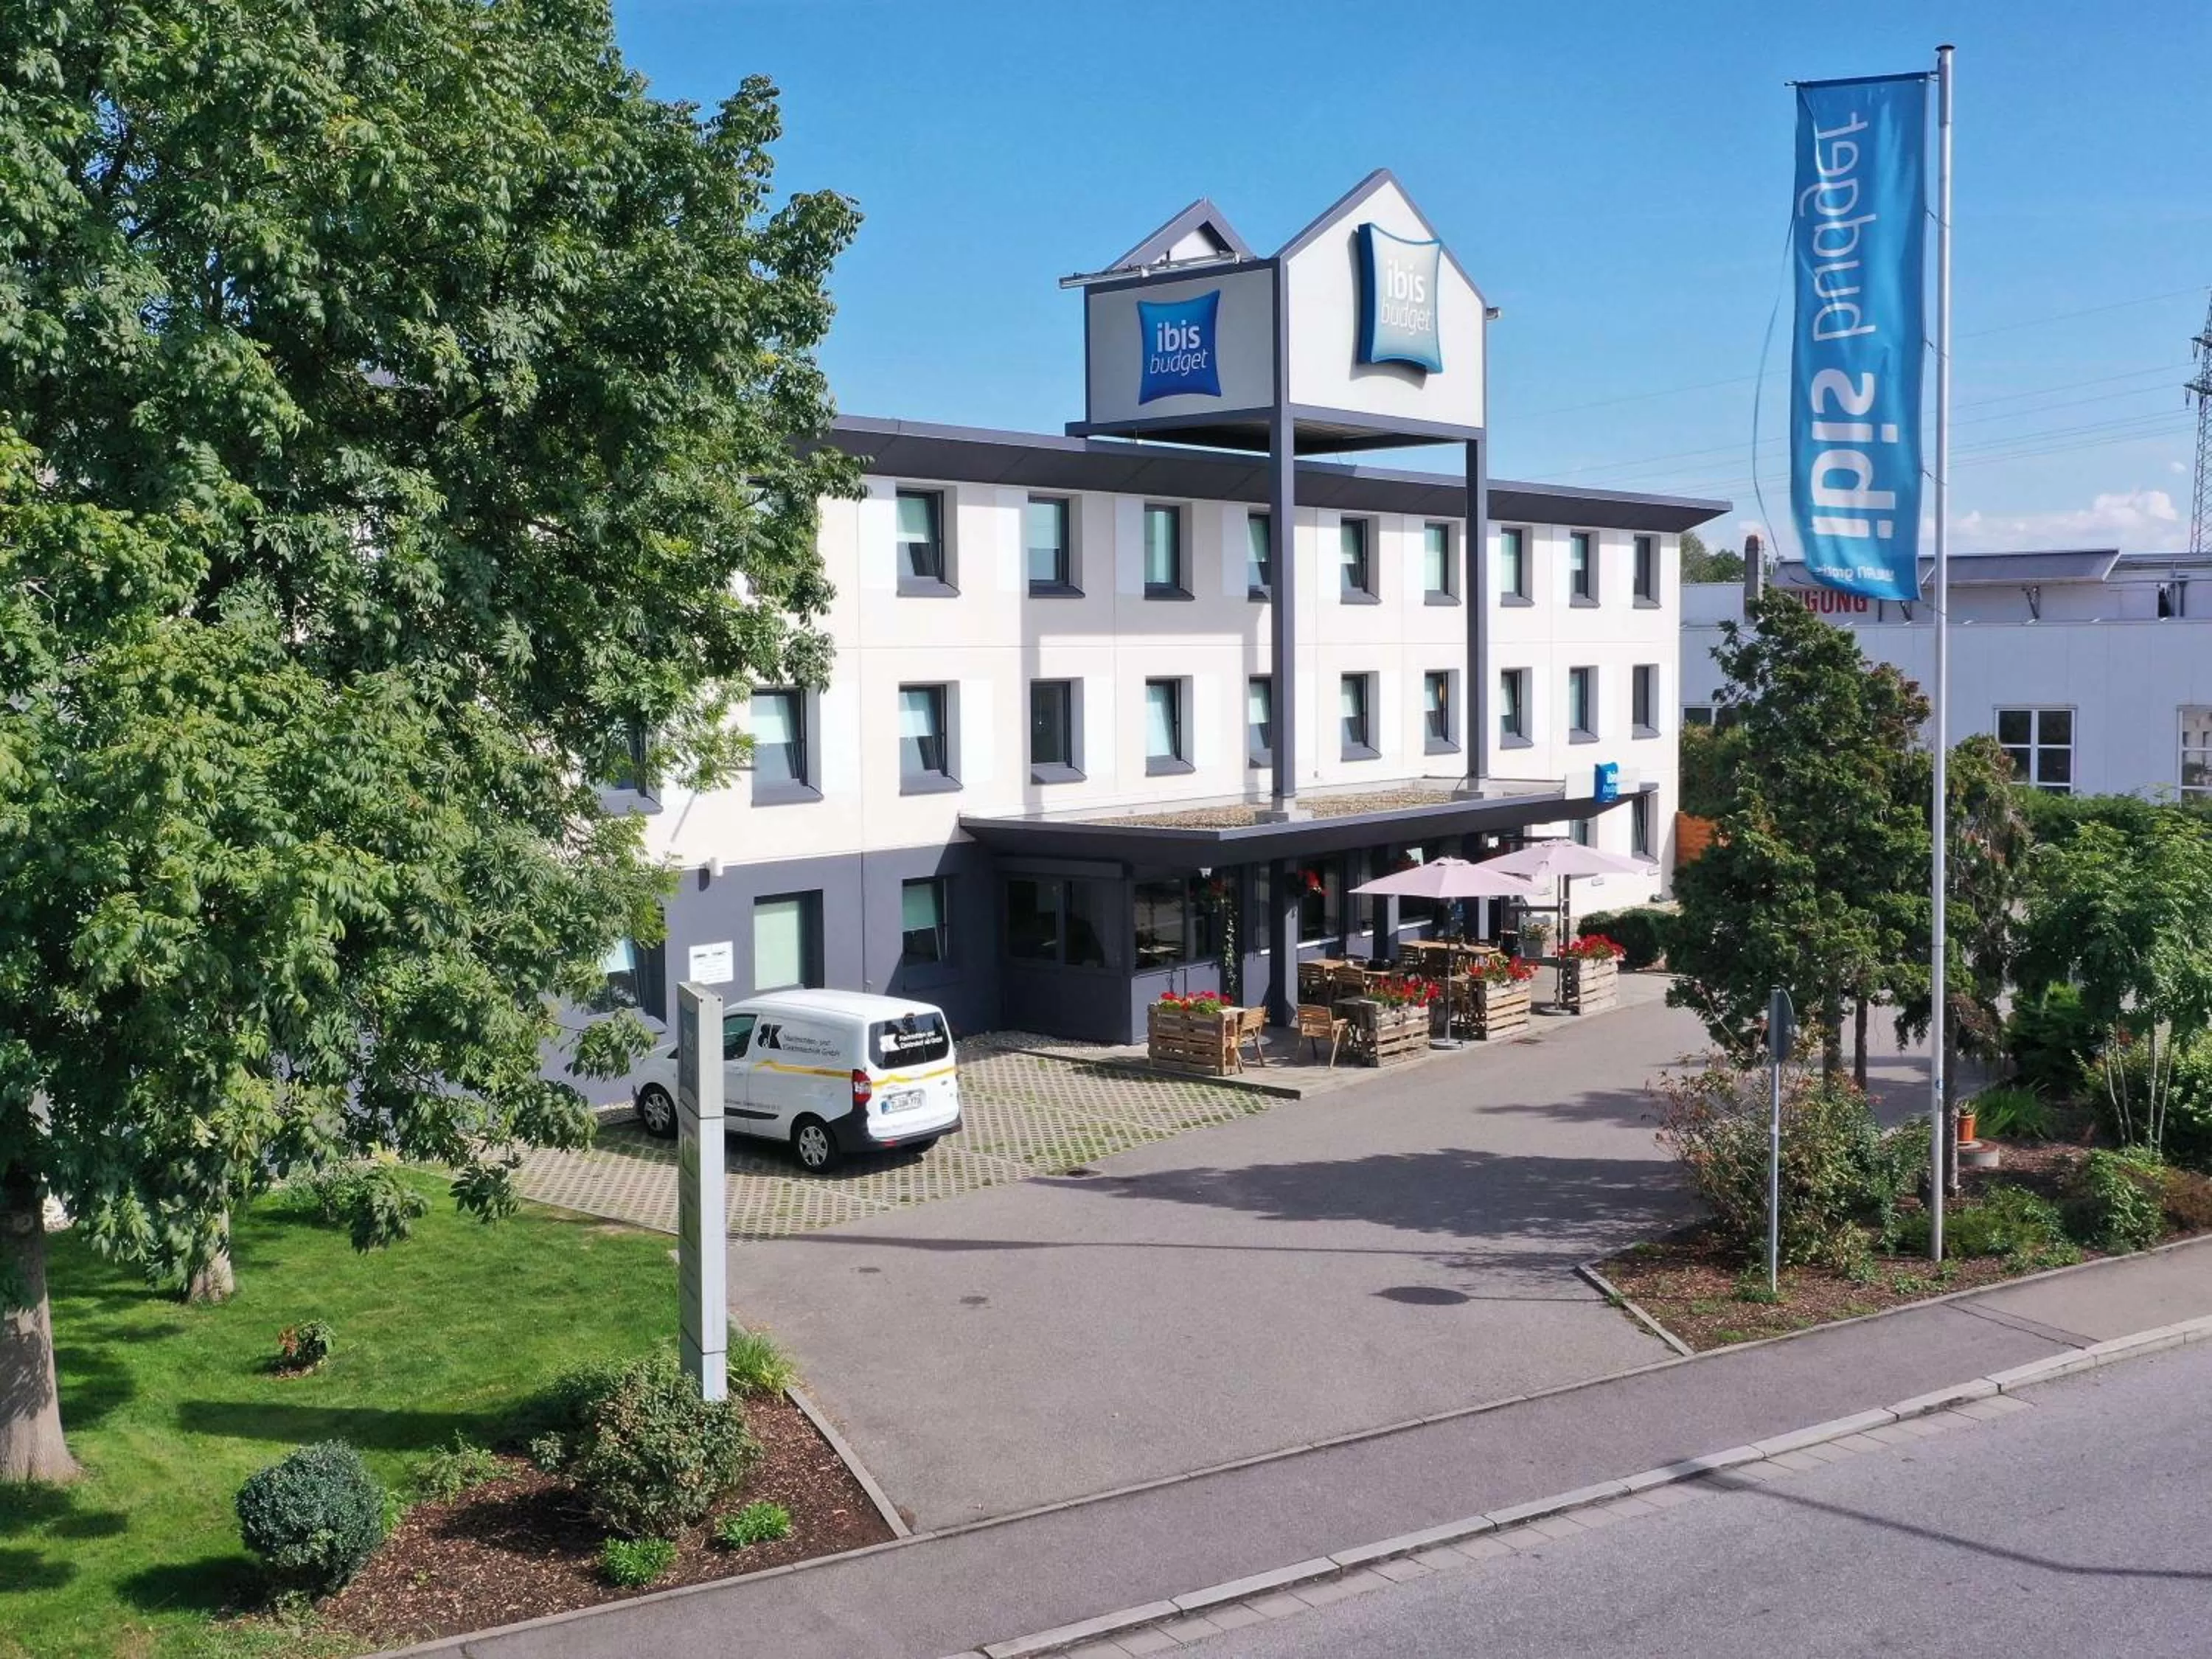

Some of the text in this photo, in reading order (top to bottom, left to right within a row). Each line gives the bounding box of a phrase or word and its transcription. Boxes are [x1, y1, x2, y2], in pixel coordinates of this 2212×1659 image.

[1387, 260, 1425, 303] ibis
[1380, 296, 1431, 335] budget
[1157, 319, 1201, 352] ibis
[1150, 349, 1208, 376] budget
